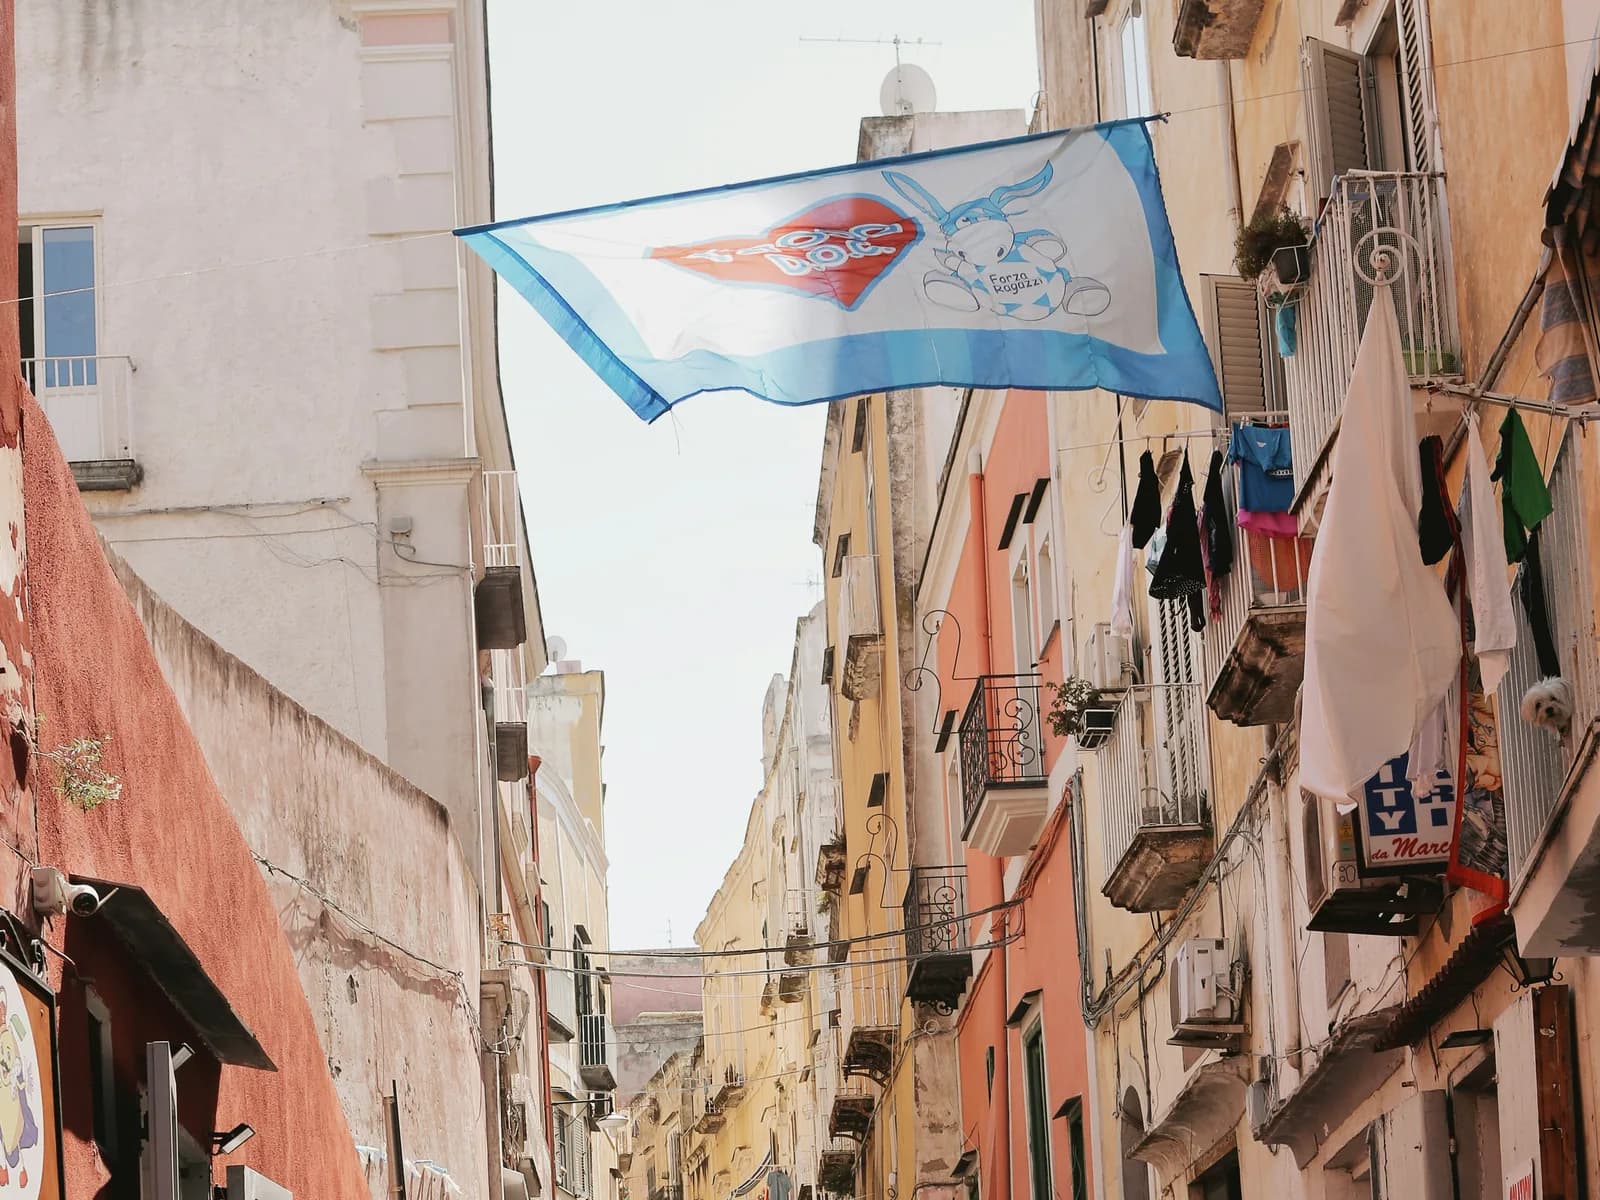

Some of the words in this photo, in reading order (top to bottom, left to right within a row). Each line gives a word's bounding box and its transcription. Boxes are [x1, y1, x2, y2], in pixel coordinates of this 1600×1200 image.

[989, 272, 1027, 285] Forza
[993, 279, 1043, 295] Ragazzi
[1371, 850, 1390, 860] da
